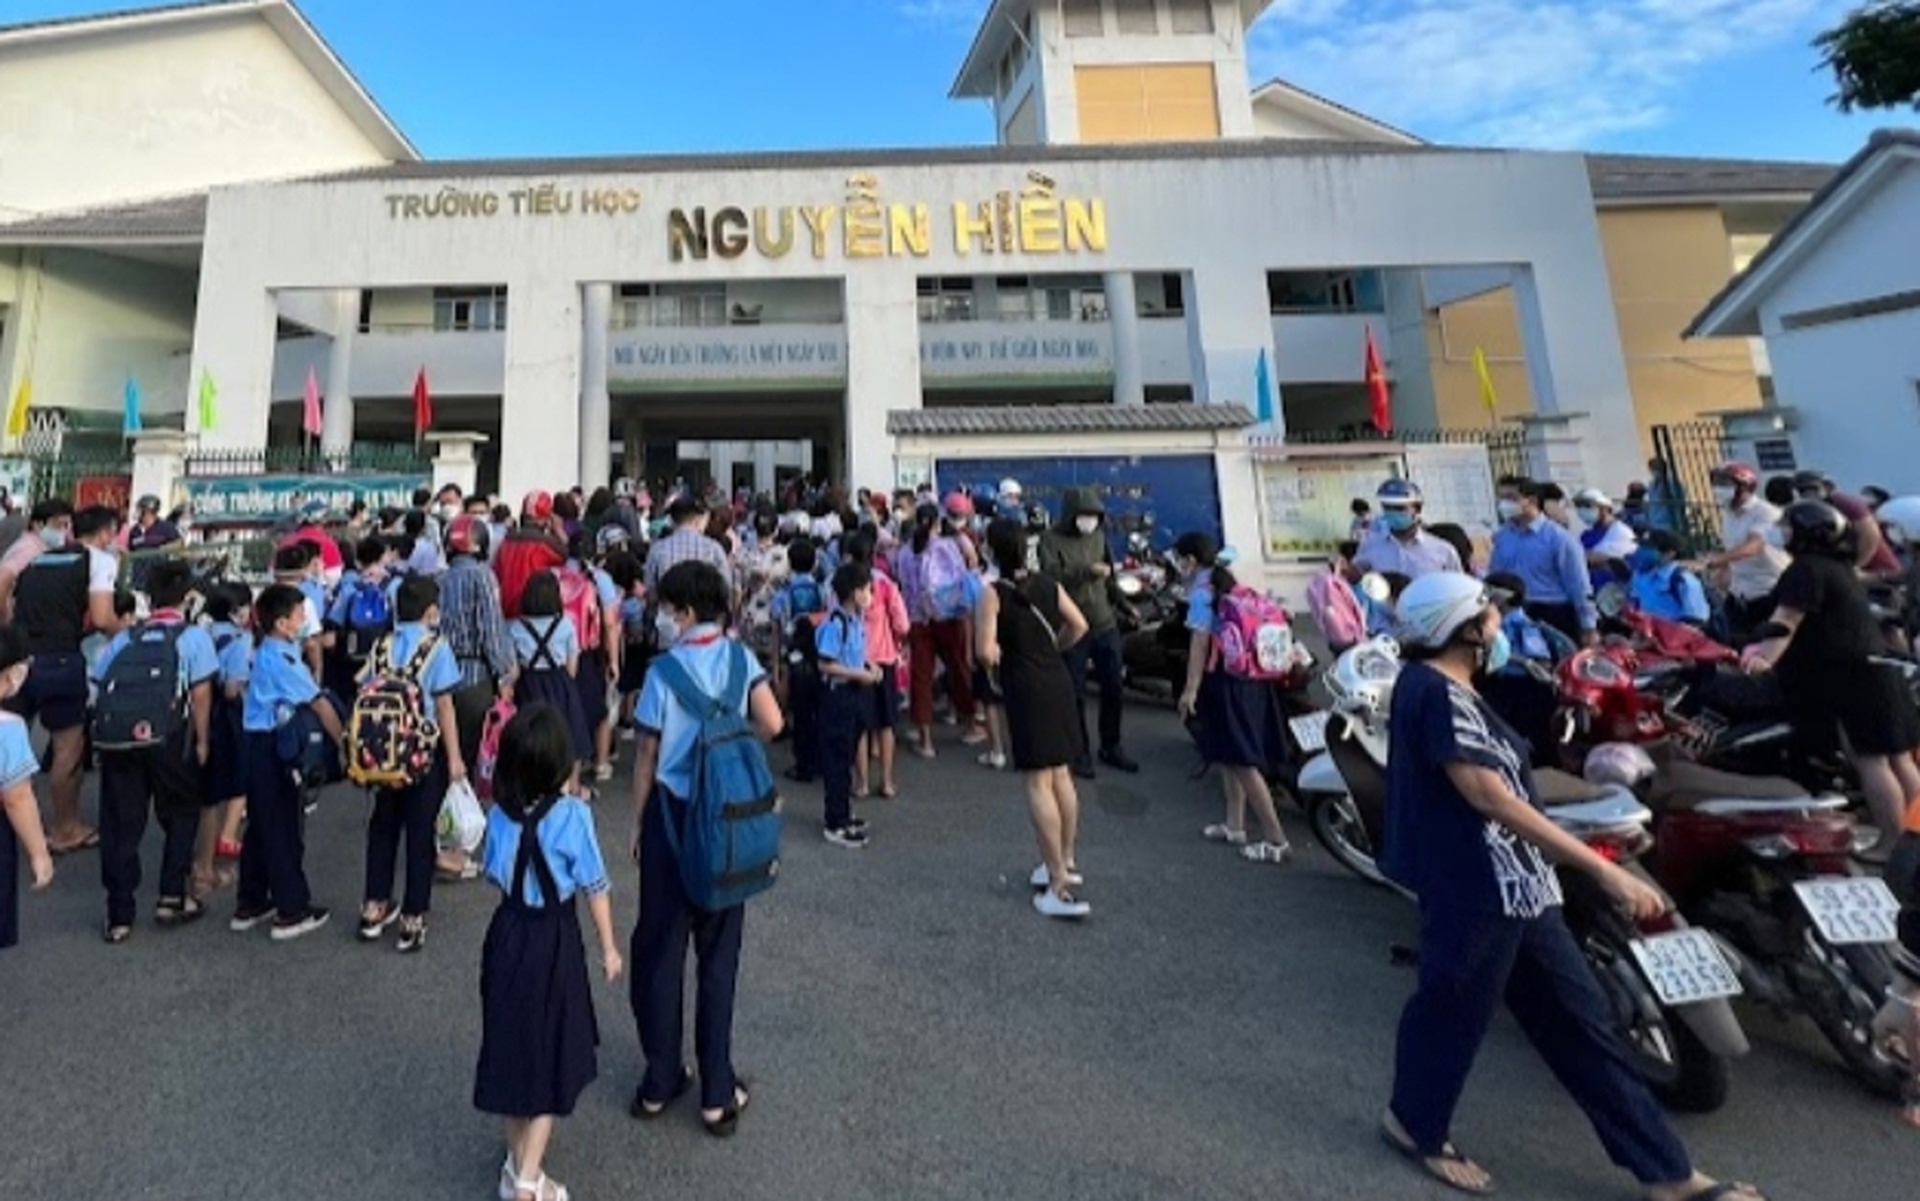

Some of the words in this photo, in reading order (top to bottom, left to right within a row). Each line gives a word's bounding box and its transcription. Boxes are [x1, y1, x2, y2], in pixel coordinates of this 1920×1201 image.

[581, 188, 642, 217] HỌC
[667, 172, 930, 262] NGUYỄN
[953, 171, 1107, 254] HIỀN
